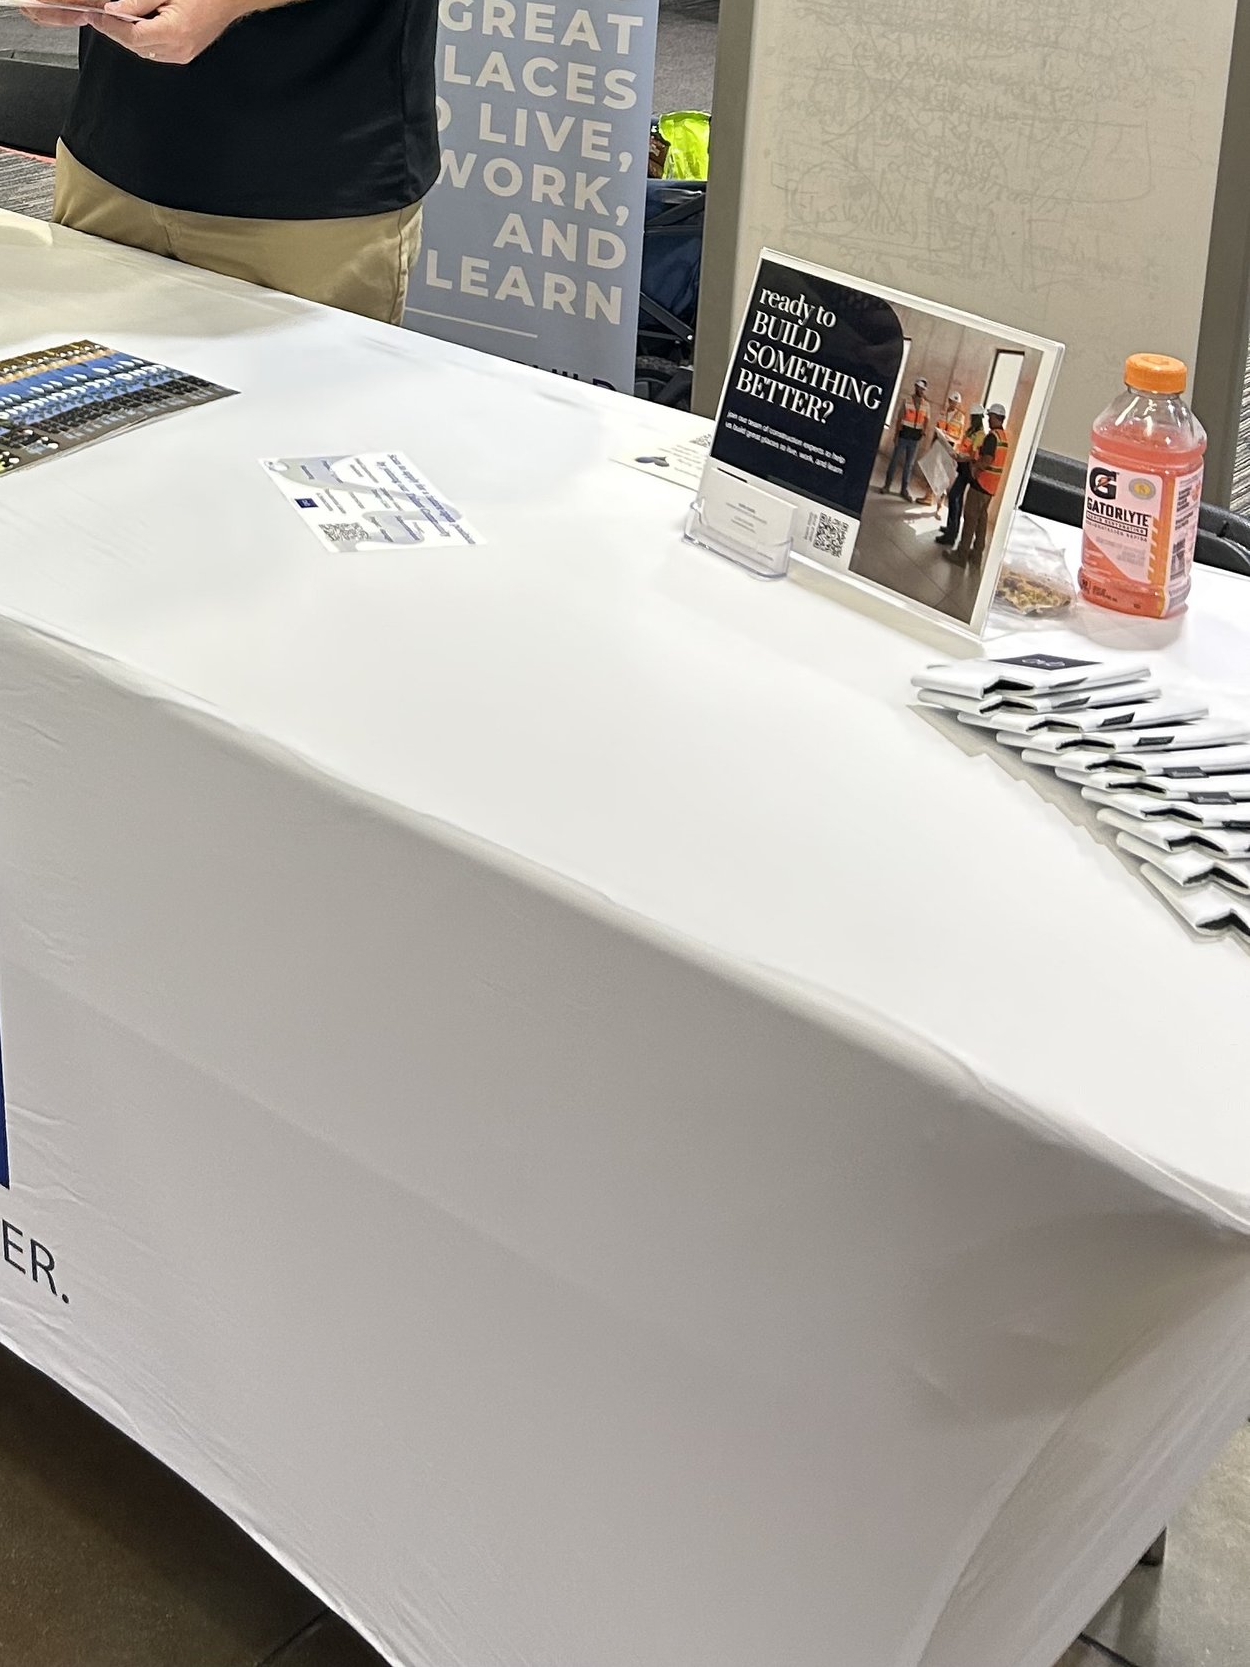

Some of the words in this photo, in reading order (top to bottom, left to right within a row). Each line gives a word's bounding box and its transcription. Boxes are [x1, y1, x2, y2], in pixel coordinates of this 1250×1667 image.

[442, 44, 637, 110] LACES
[478, 102, 633, 172] LIVE,
[435, 148, 632, 226] WORK,
[493, 213, 626, 271] AND
[425, 248, 623, 325] LEARN
[759, 287, 815, 326] ready
[816, 305, 837, 328] to
[751, 310, 822, 354] BUILD
[735, 367, 835, 424] BETTER?
[743, 339, 883, 410] SOMETHING
[1086, 496, 1150, 528] GATORLYTE
[1089, 466, 1117, 500] G
